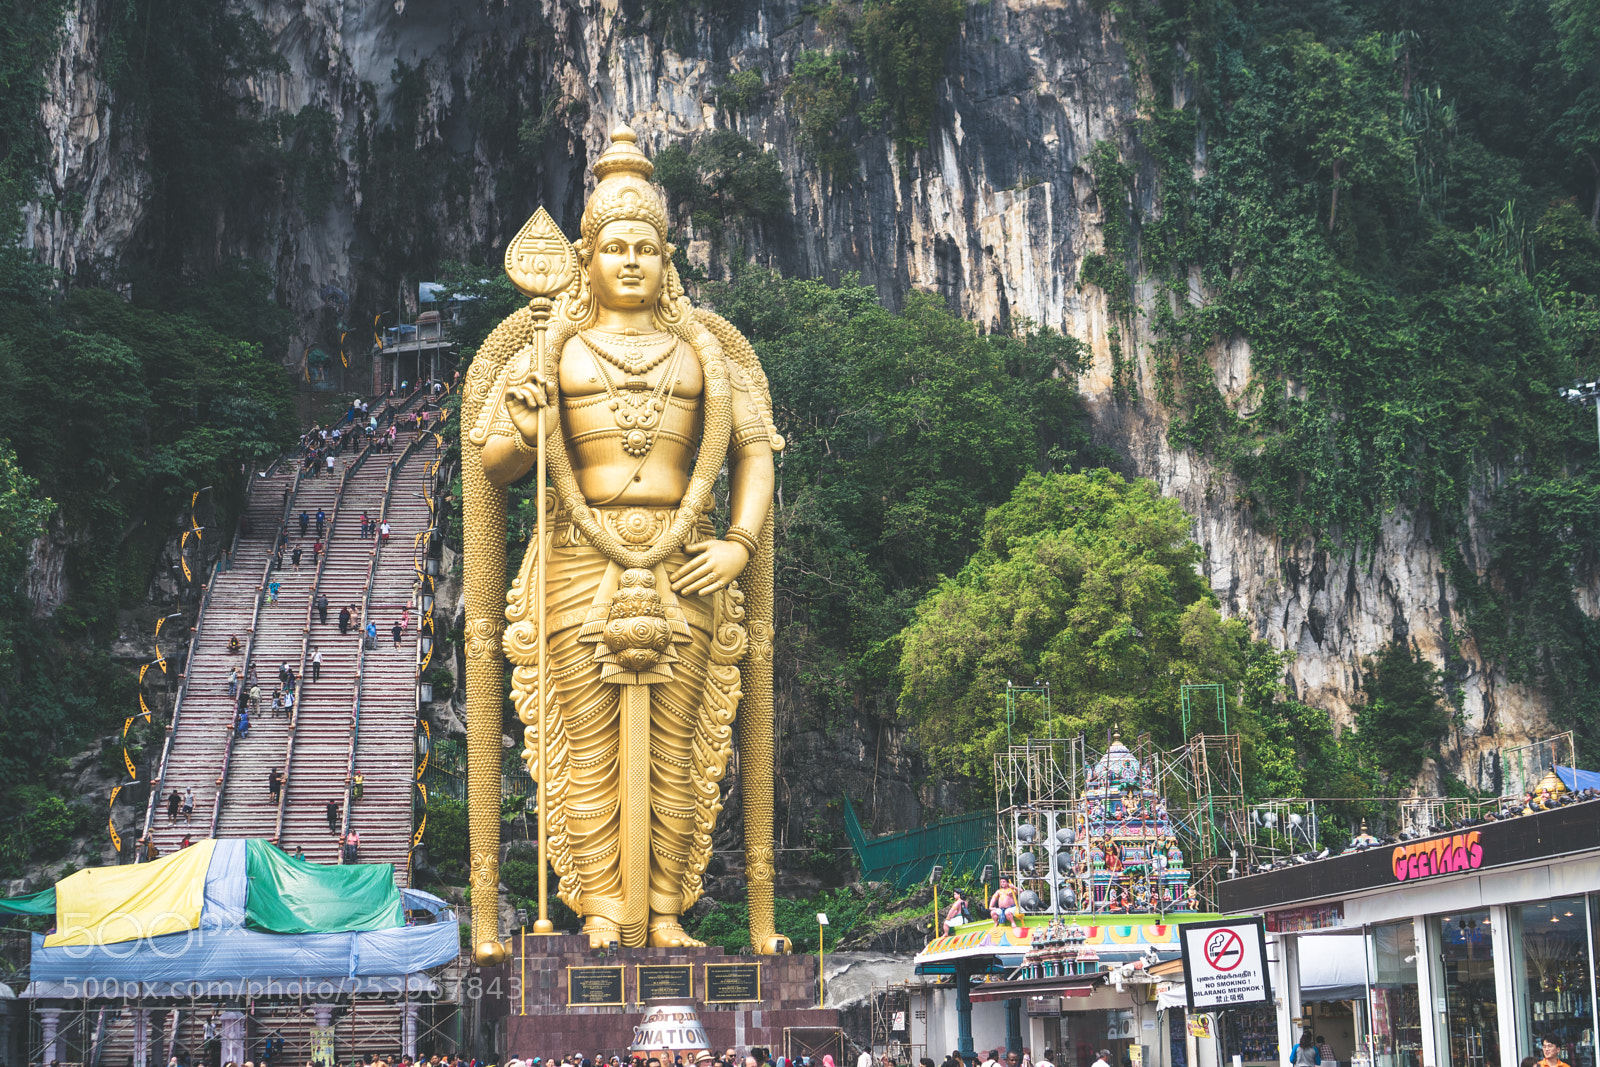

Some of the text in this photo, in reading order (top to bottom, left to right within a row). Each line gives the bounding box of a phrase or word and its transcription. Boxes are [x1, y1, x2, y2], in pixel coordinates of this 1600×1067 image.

[1216, 979, 1247, 987] SMOKING
[1193, 988, 1227, 997] DILARANG
[1228, 985, 1260, 993] MEROKOK
